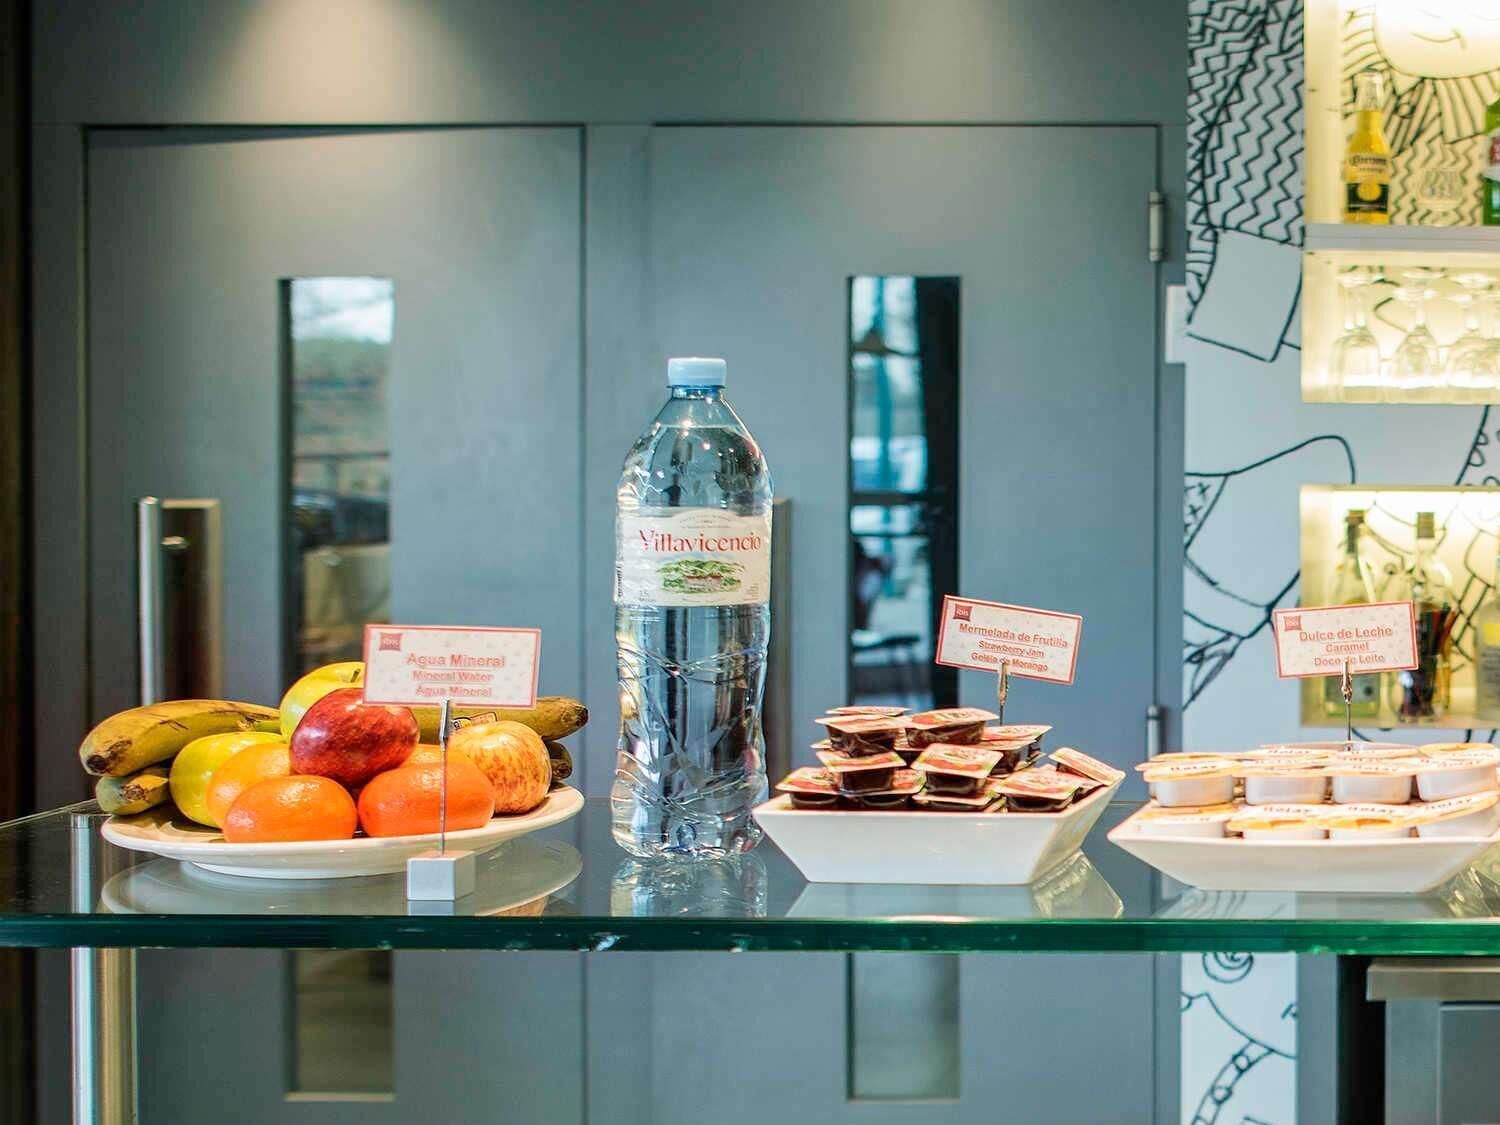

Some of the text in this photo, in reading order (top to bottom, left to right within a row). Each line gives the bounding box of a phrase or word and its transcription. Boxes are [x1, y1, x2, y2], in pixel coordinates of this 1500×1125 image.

[639, 529, 762, 552] Villavicencio
[959, 623, 1068, 648] Mermelada de Frutilla
[1299, 626, 1393, 642] Dulce de Leche
[978, 640, 1044, 658] Strawberry Jam
[1326, 642, 1369, 653] Caramel
[406, 653, 506, 668] Agua Mineral
[1012, 659, 1048, 673] Morango
[1314, 657, 1341, 666] Doce
[1359, 654, 1385, 665] Leite
[412, 670, 494, 682] Mineral Water
[449, 686, 492, 697] Mineral
